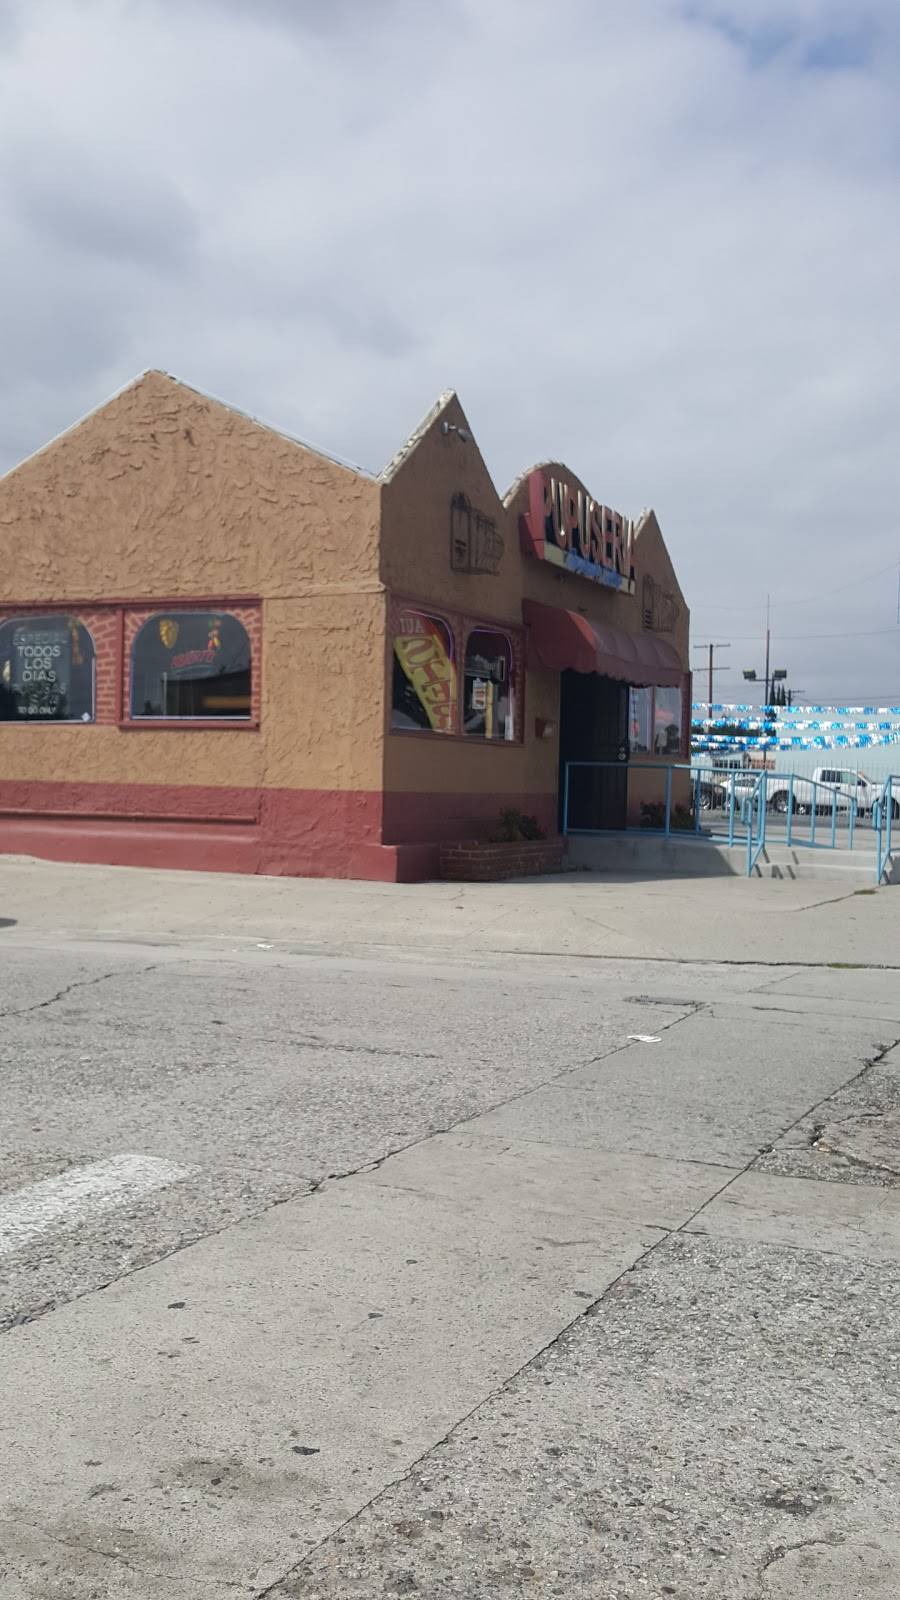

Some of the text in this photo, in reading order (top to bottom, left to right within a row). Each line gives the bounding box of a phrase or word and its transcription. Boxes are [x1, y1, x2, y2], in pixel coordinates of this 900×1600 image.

[17, 645, 61, 657] TODOS
[24, 658, 52, 670] LOS
[22, 670, 56, 682] DIAS
